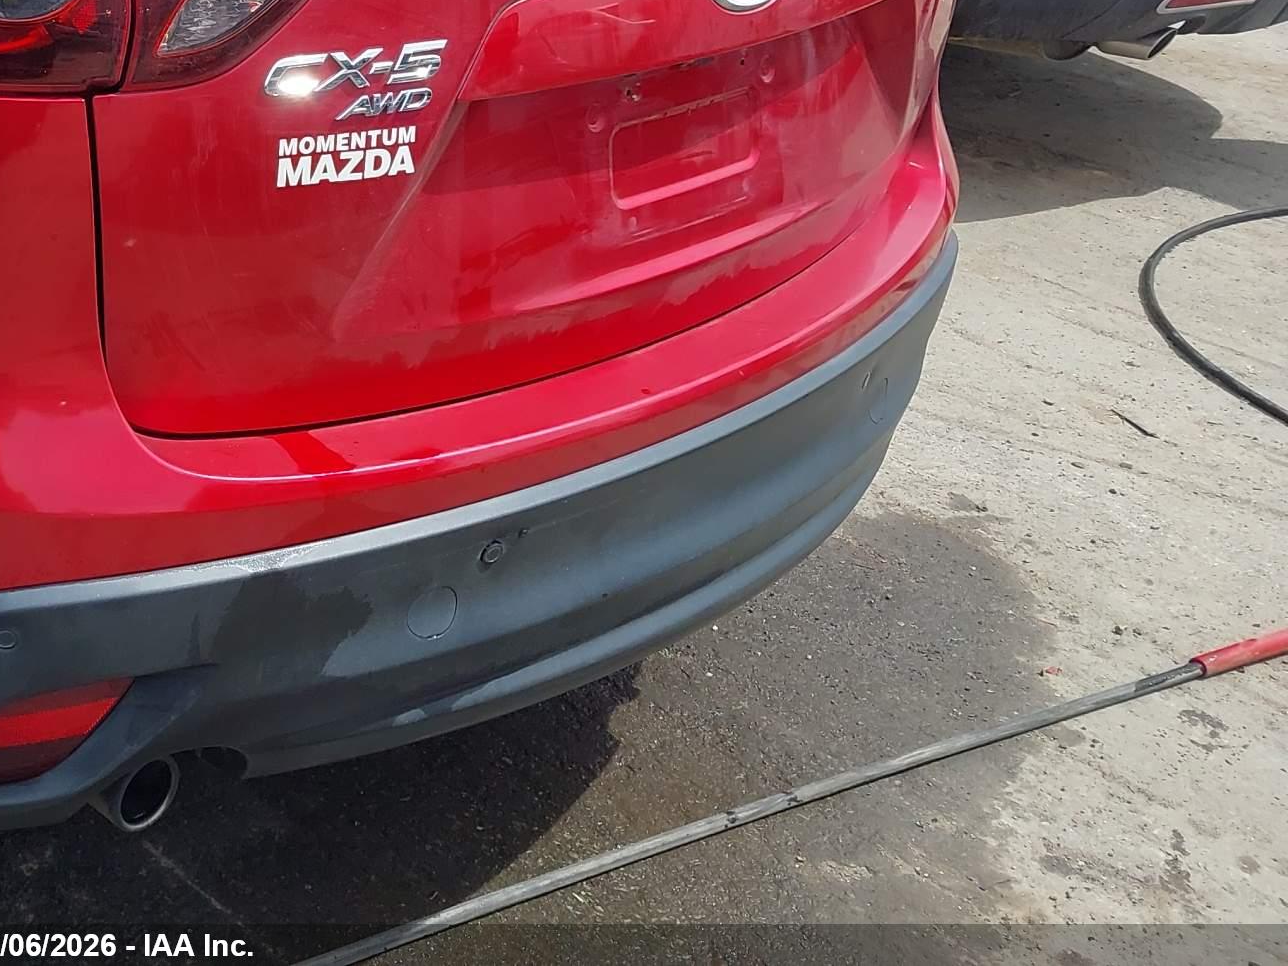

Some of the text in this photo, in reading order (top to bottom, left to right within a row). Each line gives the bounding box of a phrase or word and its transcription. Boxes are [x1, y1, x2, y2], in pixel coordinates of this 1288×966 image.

[264, 39, 448, 97] CX-5
[335, 87, 432, 121] AWD
[278, 126, 417, 157] MOMENTUM
[276, 145, 415, 188] MAZDA
